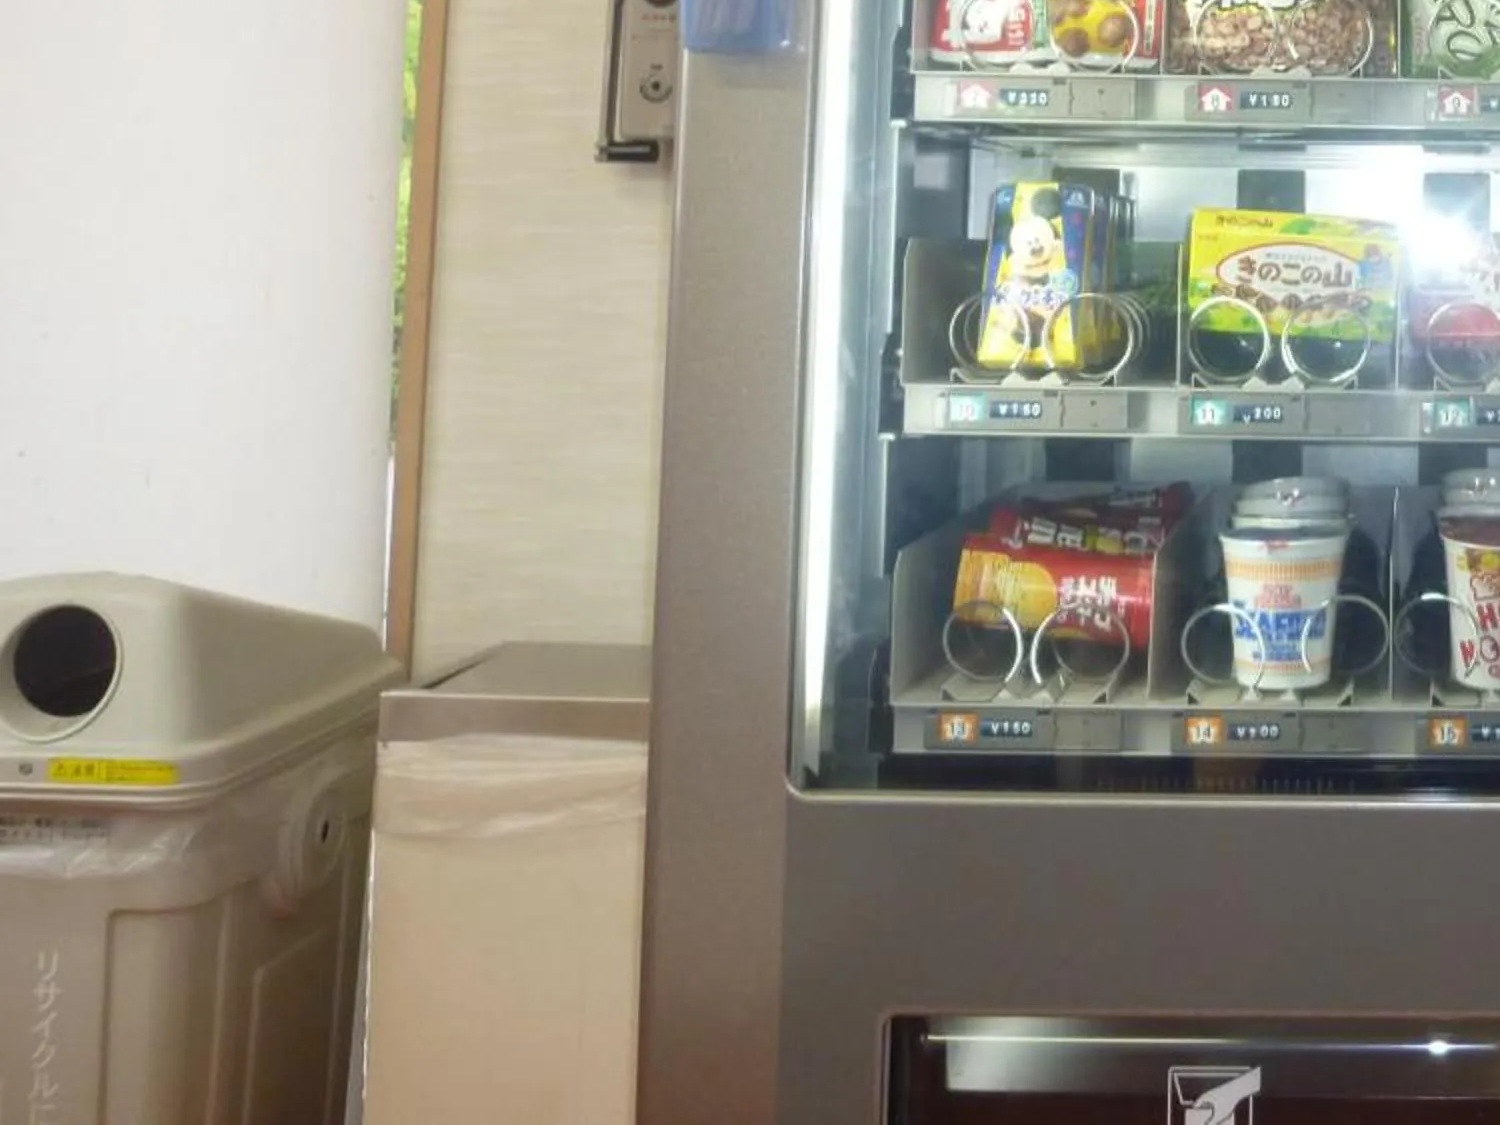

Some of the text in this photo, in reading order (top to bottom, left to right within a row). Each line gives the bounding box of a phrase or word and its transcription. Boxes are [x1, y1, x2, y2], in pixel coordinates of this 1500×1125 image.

[1237, 256, 1353, 287] きのこの山
